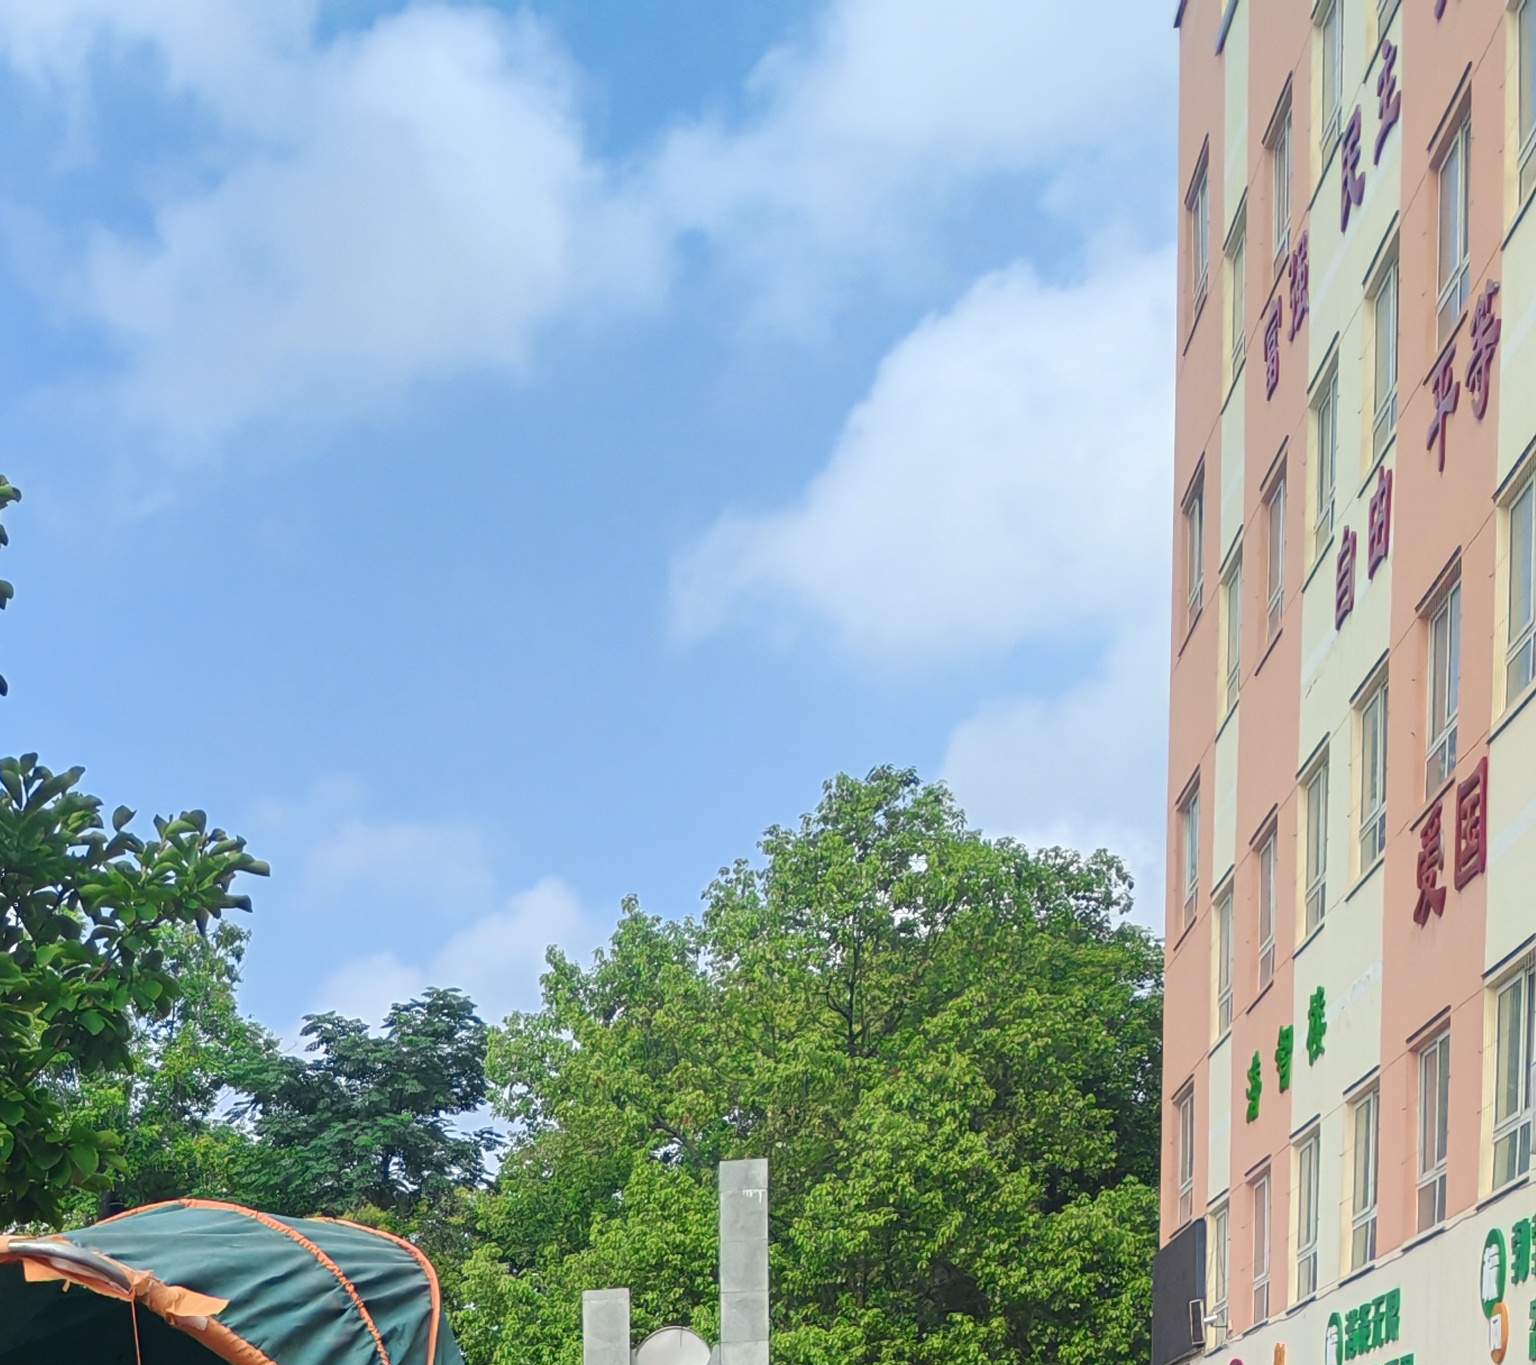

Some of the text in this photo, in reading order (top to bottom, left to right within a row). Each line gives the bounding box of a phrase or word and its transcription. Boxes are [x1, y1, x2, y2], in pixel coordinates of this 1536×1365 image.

[1264, 39, 1402, 402] 富强 民主
[1335, 278, 1501, 631] 自由 平等
[1413, 756, 1489, 928] 爱国
